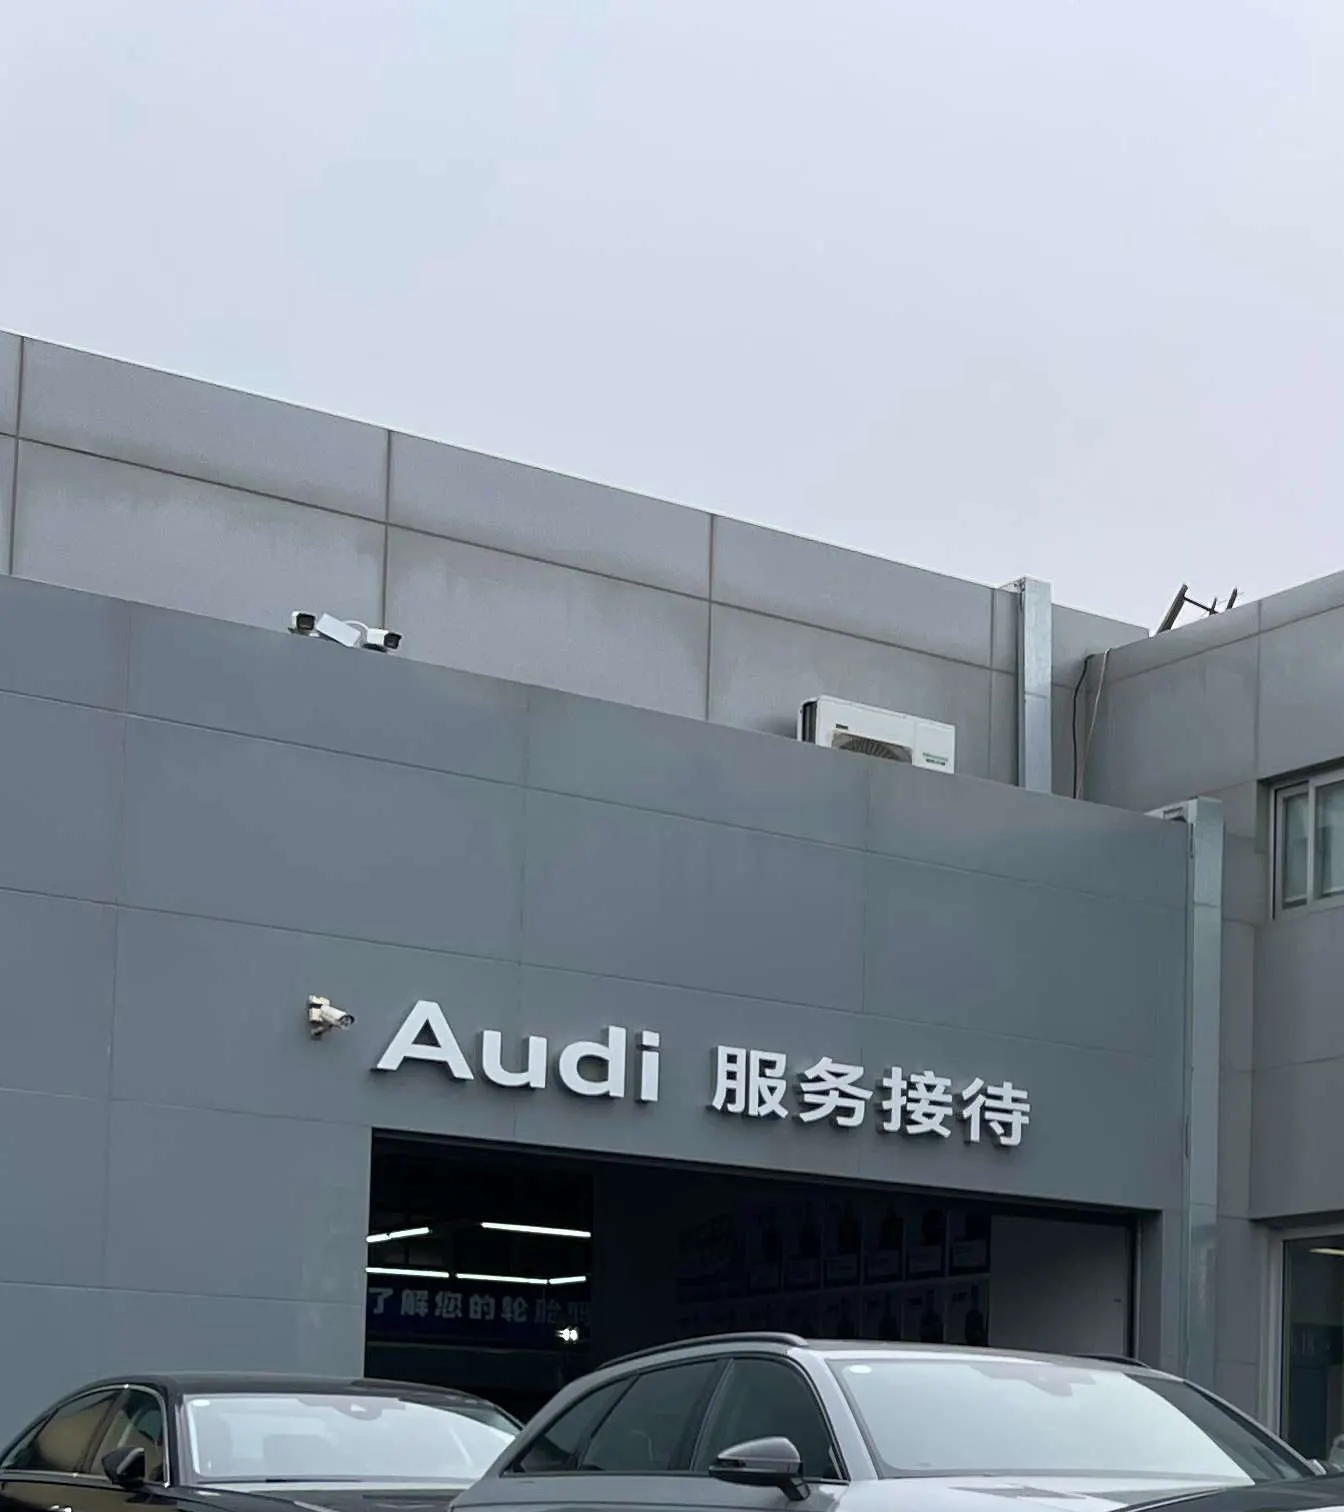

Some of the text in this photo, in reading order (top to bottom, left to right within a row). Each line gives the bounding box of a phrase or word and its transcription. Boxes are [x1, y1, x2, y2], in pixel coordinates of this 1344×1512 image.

[374, 1000, 1031, 1147] Audi 服务接待
